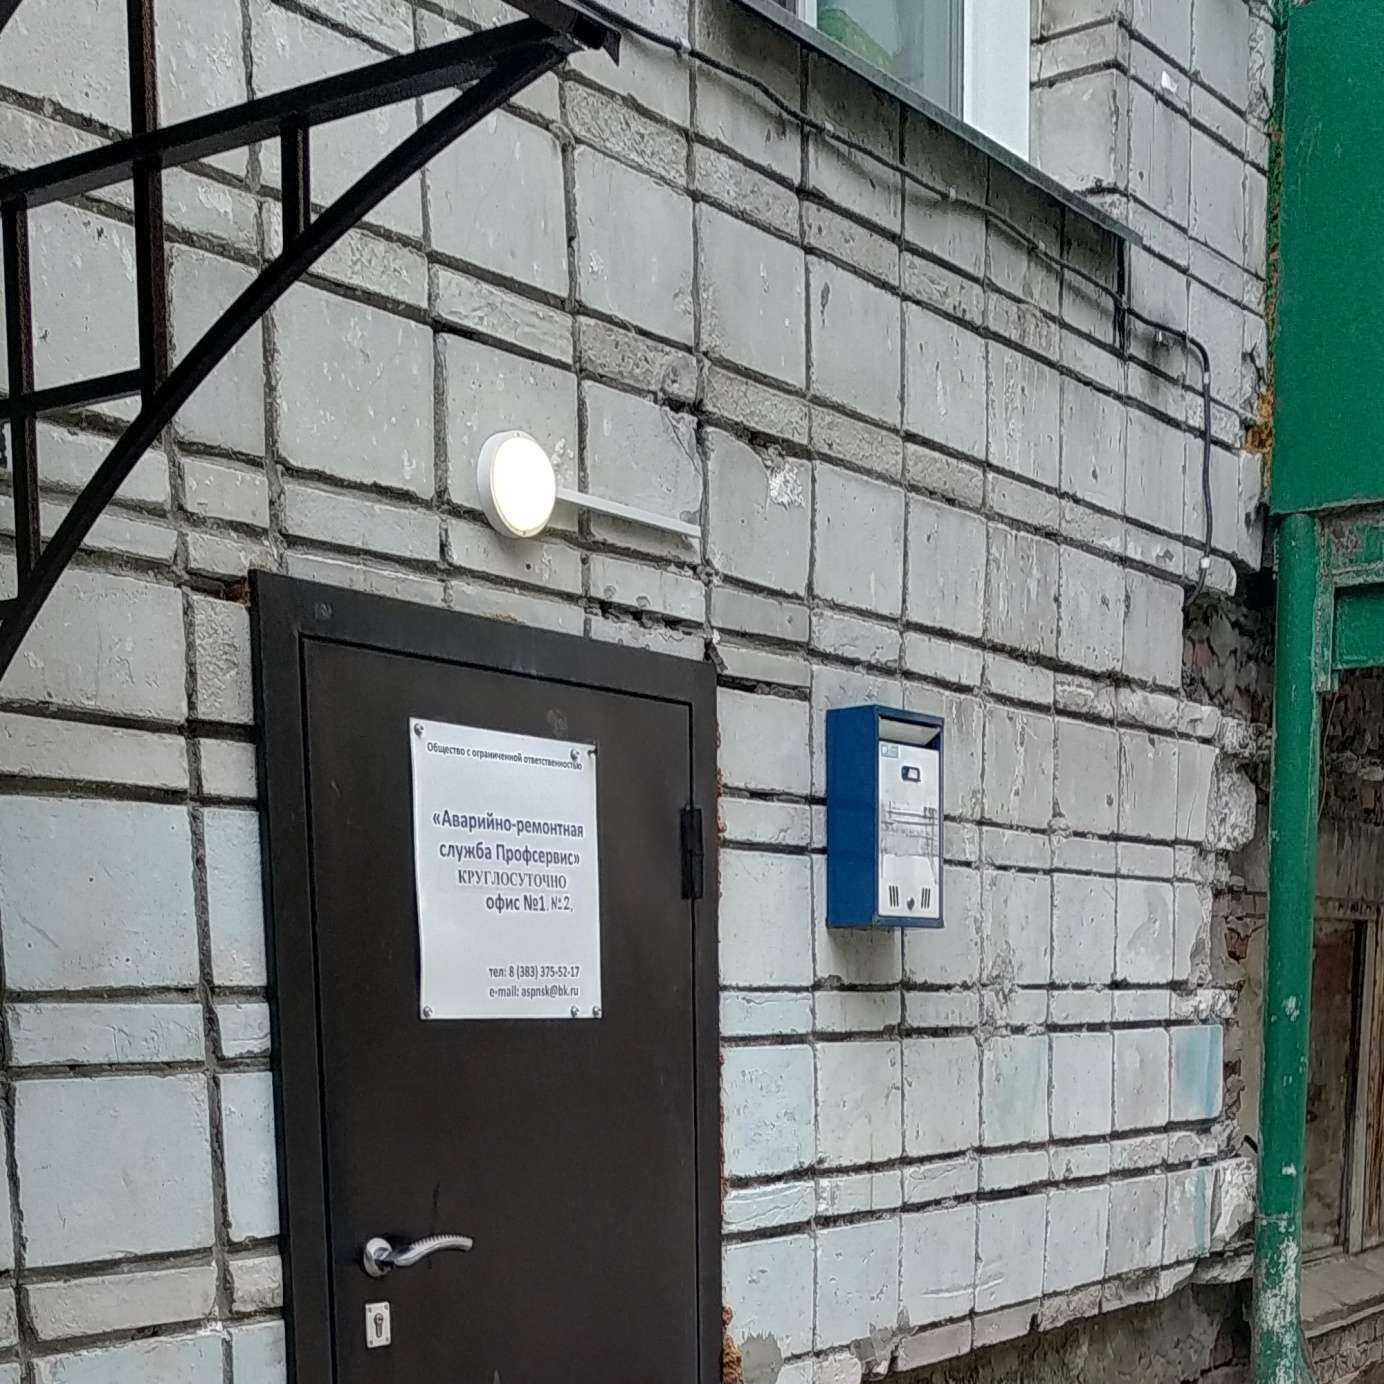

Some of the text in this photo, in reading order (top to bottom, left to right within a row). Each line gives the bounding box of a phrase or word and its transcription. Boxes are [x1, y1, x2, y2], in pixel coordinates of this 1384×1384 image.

[427, 742, 465, 756] Общество
[472, 750, 522, 763] ограниченной
[523, 756, 582, 770] ответственностью
[432, 809, 584, 838] «Аварийно-ремонтная
[439, 842, 580, 867] служба Профсервис»
[458, 869, 567, 889] КРУГЛОСУТОЧНО
[486, 893, 520, 913] офис
[488, 964, 580, 980] тел: 8 (383) 375-52-17
[489, 984, 579, 1000] e-mail: aspnsk@bk.ru
